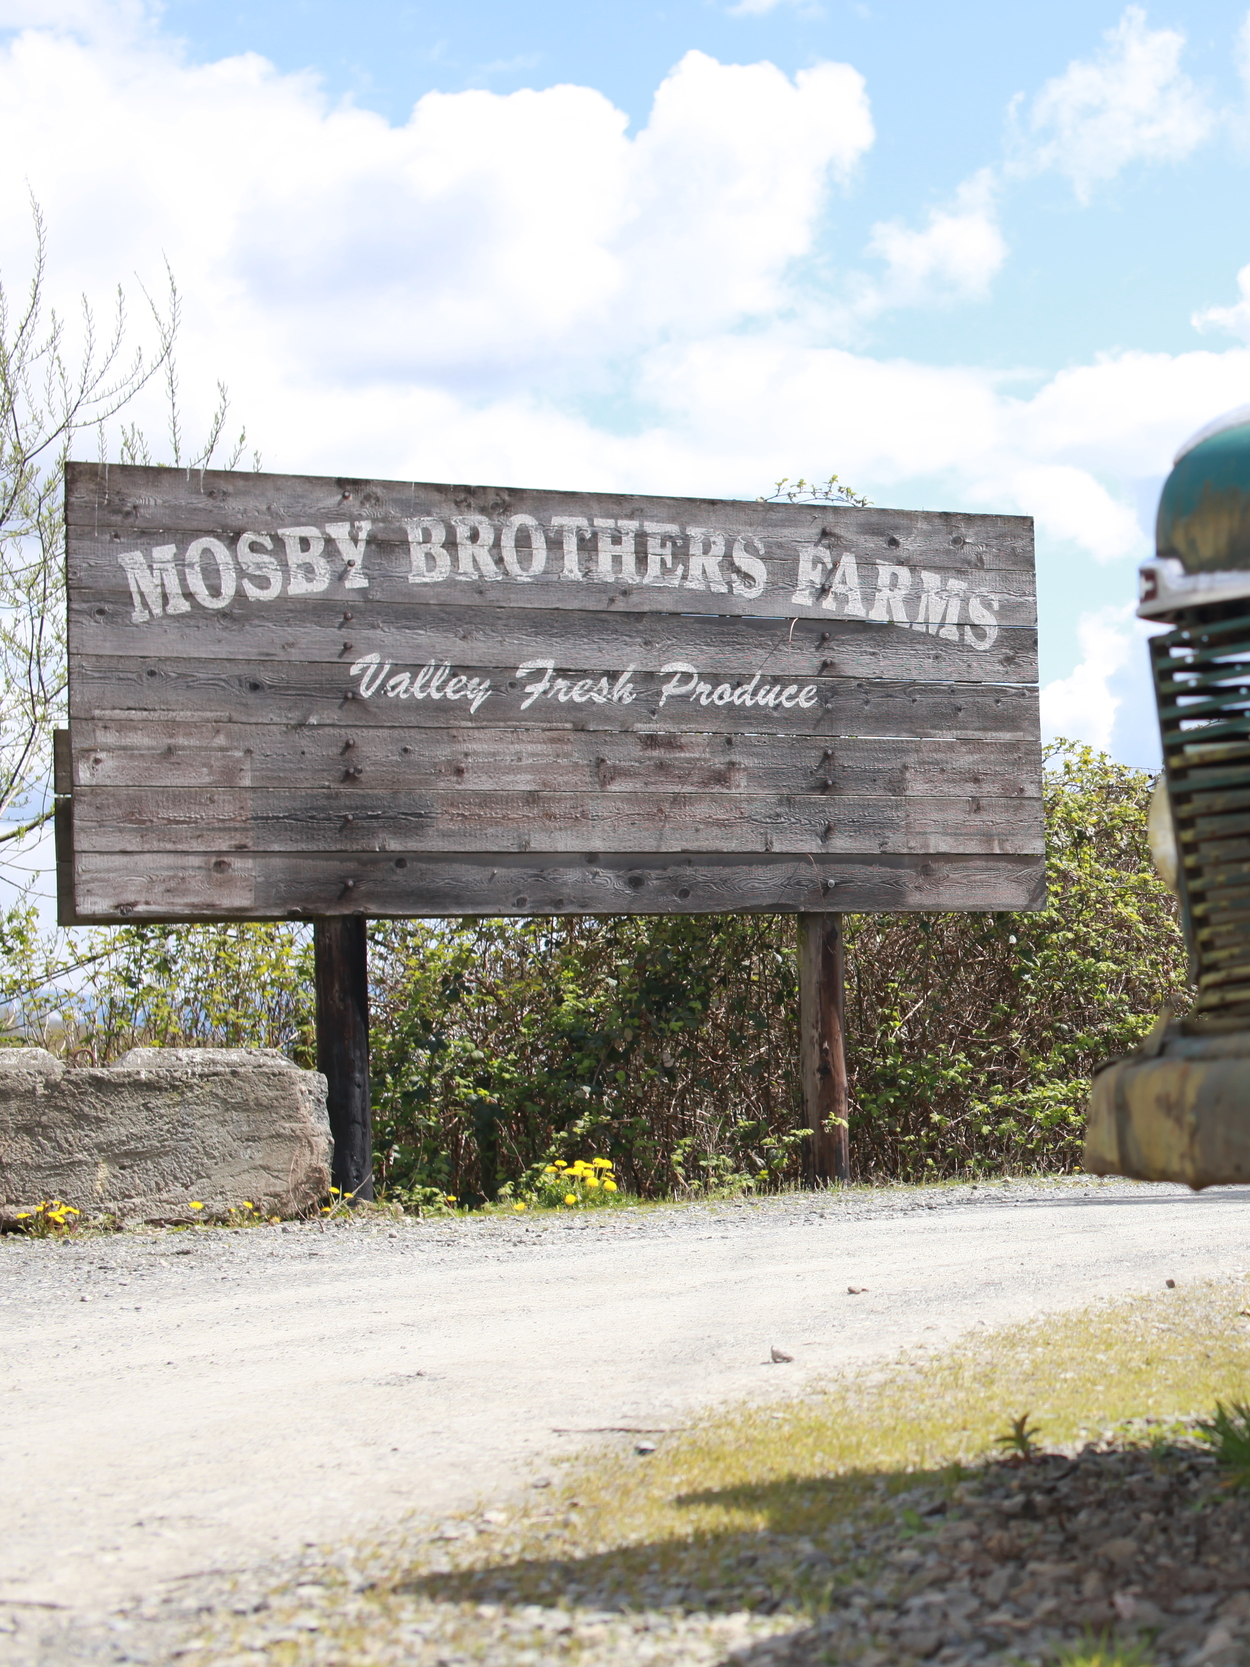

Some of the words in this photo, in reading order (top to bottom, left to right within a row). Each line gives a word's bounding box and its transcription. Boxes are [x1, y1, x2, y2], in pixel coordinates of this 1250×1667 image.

[118, 520, 372, 622] MOSBY
[407, 514, 767, 599] BROTHERS
[792, 546, 999, 650] FARMS
[350, 652, 492, 714] Valley
[515, 658, 637, 711] Fresh
[659, 662, 818, 708] Produce
